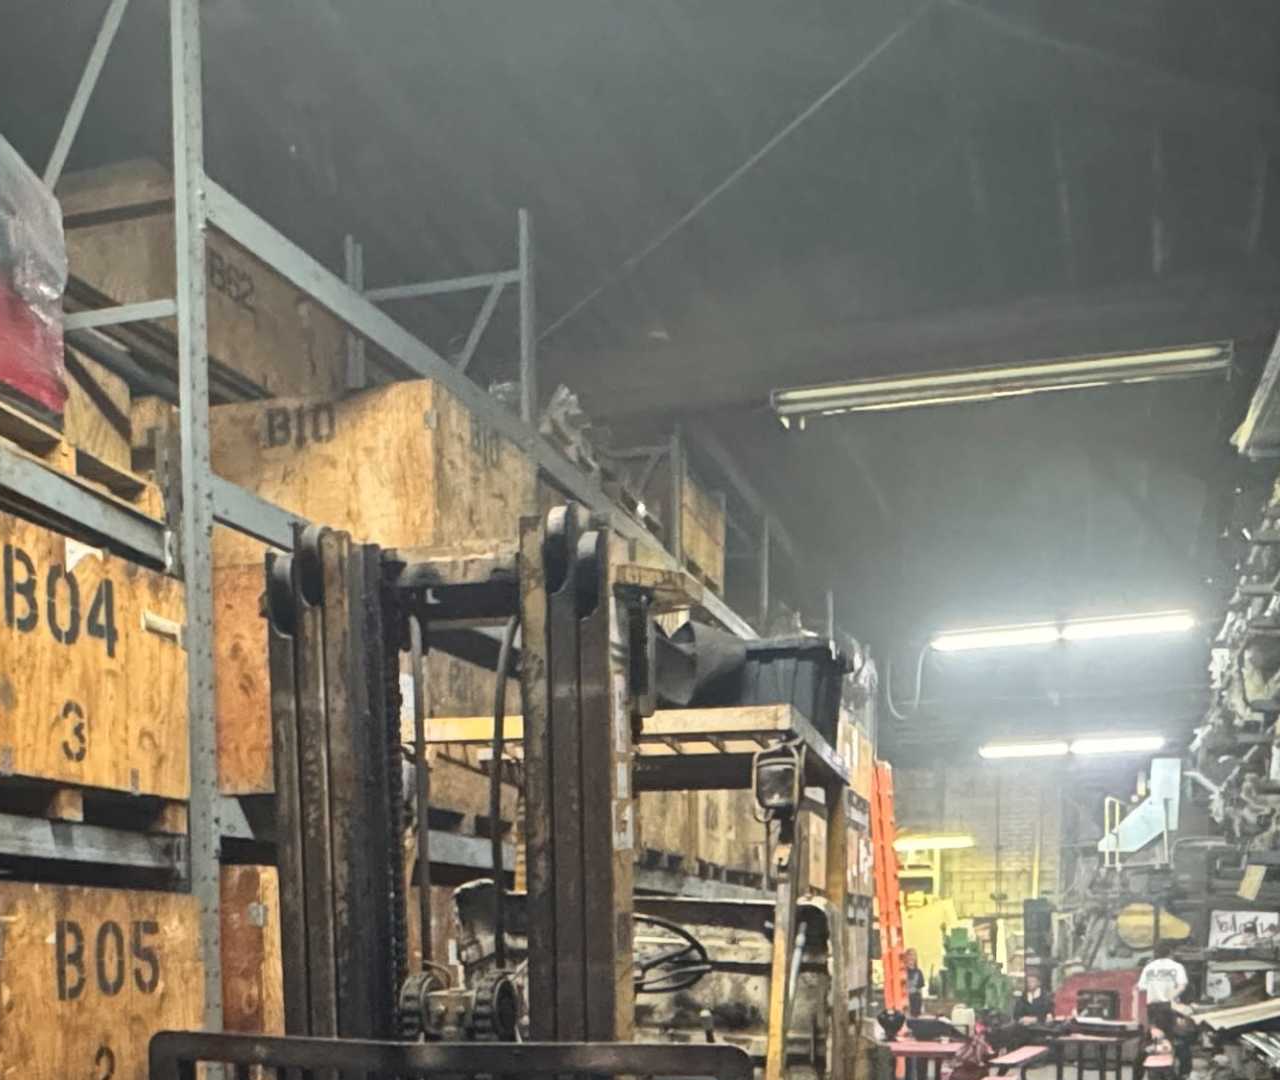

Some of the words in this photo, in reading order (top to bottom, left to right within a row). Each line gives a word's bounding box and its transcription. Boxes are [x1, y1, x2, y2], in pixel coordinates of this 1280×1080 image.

[266, 401, 336, 448] B10
[4, 544, 118, 657] B04
[62, 702, 86, 762] 3
[56, 921, 160, 1000] B05
